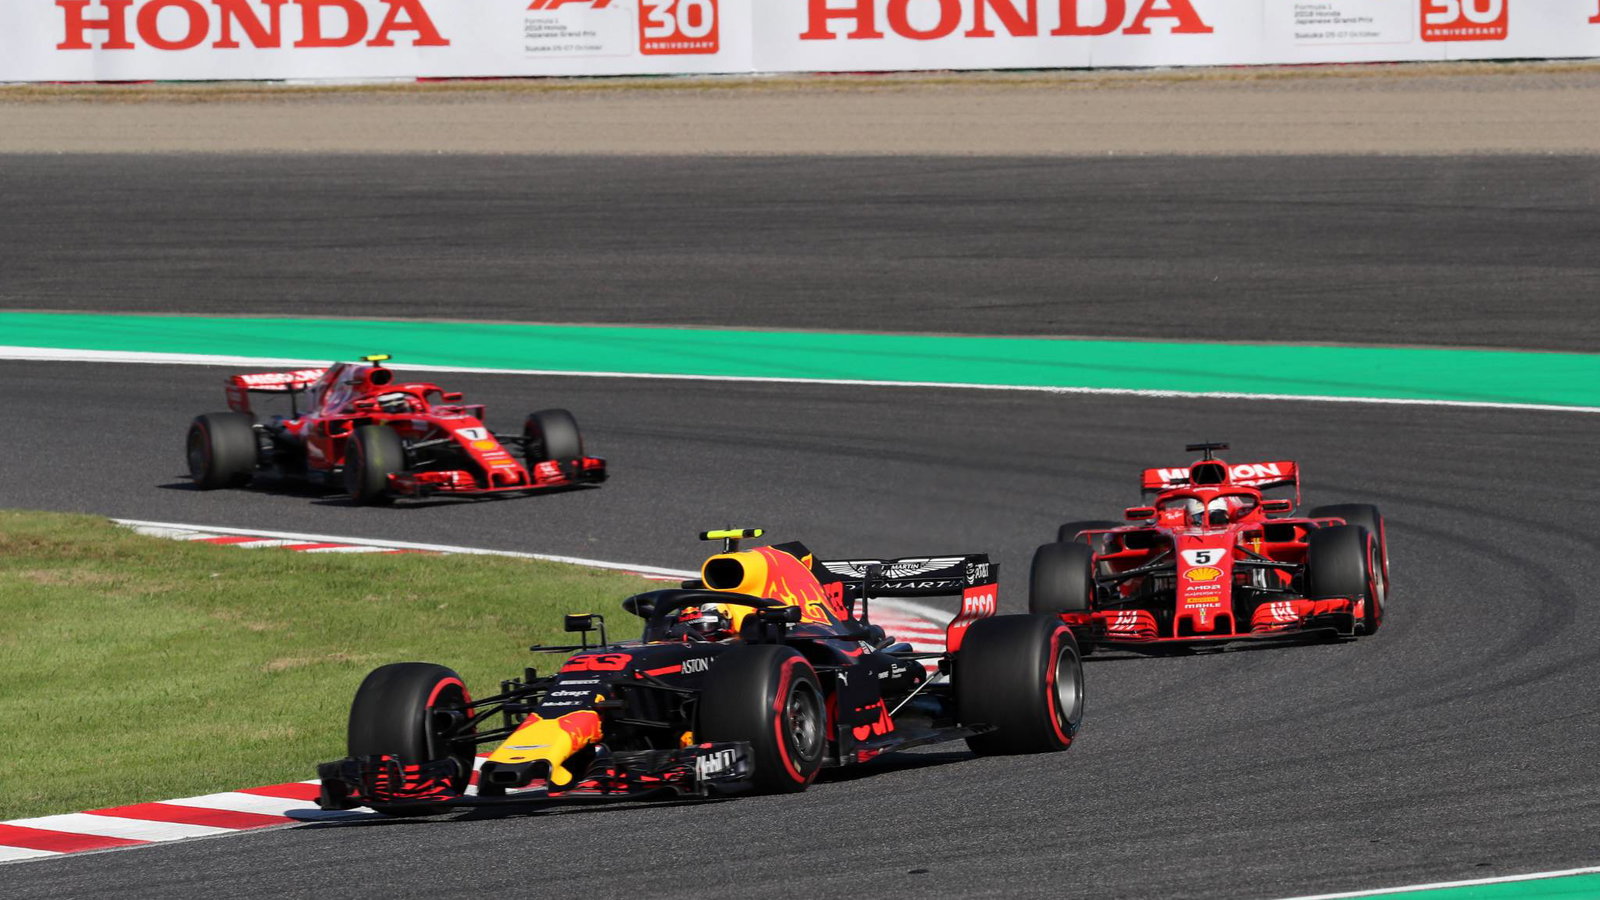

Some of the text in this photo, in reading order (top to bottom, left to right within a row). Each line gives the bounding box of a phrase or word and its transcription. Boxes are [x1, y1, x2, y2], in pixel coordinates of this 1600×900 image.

[55, 0, 450, 50] HONDA
[642, 0, 714, 38] 30
[800, 0, 1214, 40] HONDA
[1426, 27, 1502, 36] ANNIVERSARY
[645, 41, 714, 49] ANNIVERSARY
[466, 429, 479, 439] 7
[1195, 551, 1210, 564] 5
[560, 653, 633, 672] 33
[681, 657, 709, 674] ASTON
